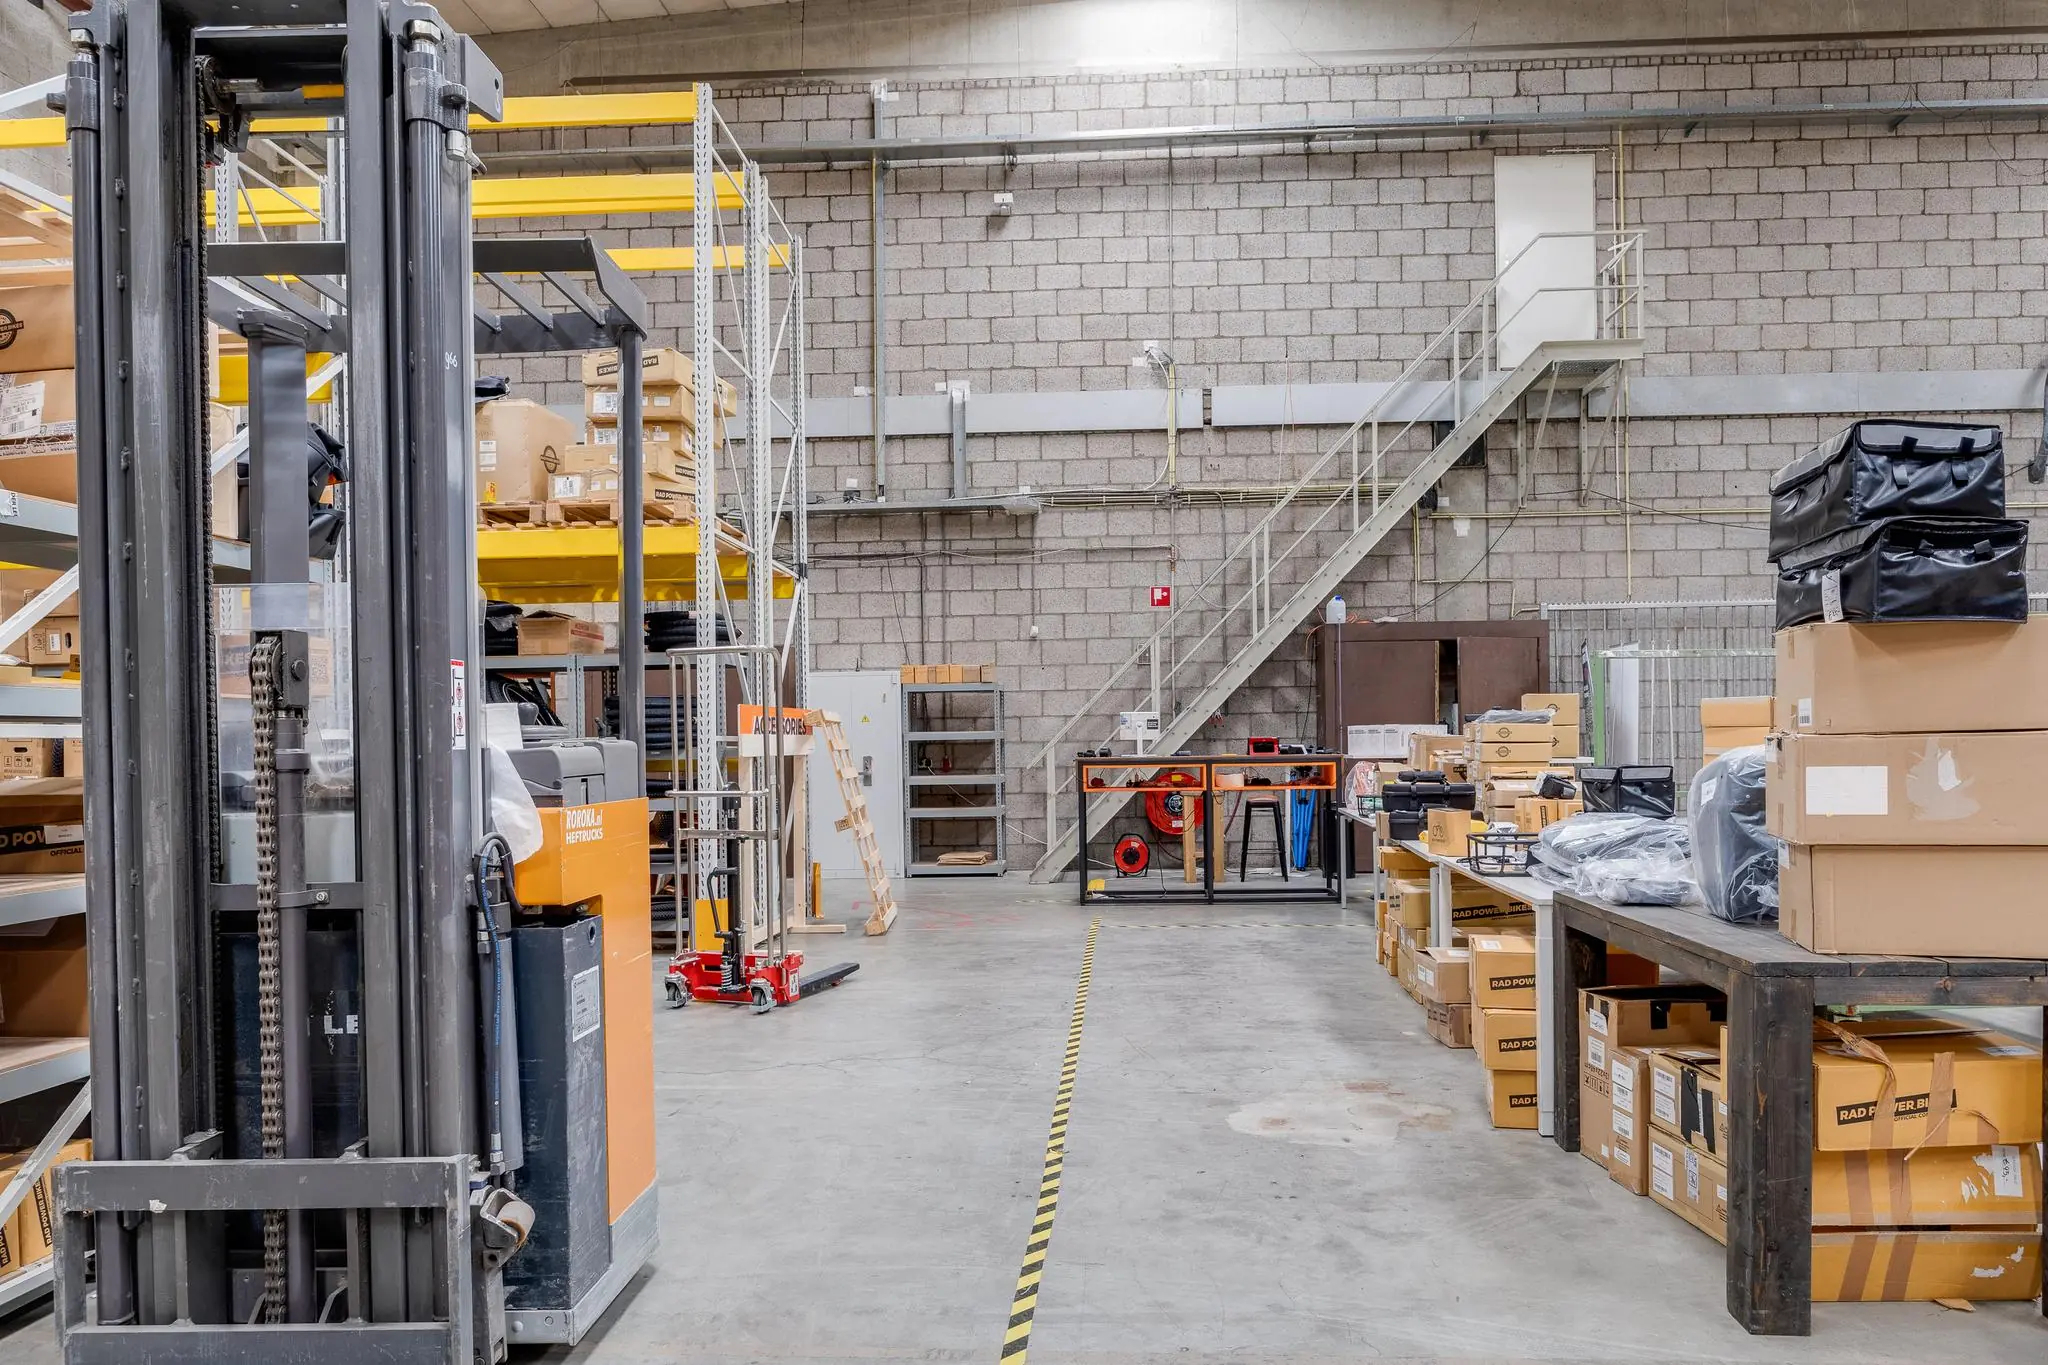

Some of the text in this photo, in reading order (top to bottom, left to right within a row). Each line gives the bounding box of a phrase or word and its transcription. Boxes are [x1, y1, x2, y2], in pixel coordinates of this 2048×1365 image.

[566, 828, 604, 845] HEFTRUCKS
[1453, 909, 1472, 919] RAD
[1473, 906, 1500, 917] POWE
[1492, 977, 1536, 988] RAD POW
[1501, 1040, 1520, 1049] RAD
[1511, 1097, 1531, 1105] RAD
[1839, 1107, 1868, 1121] RAD
